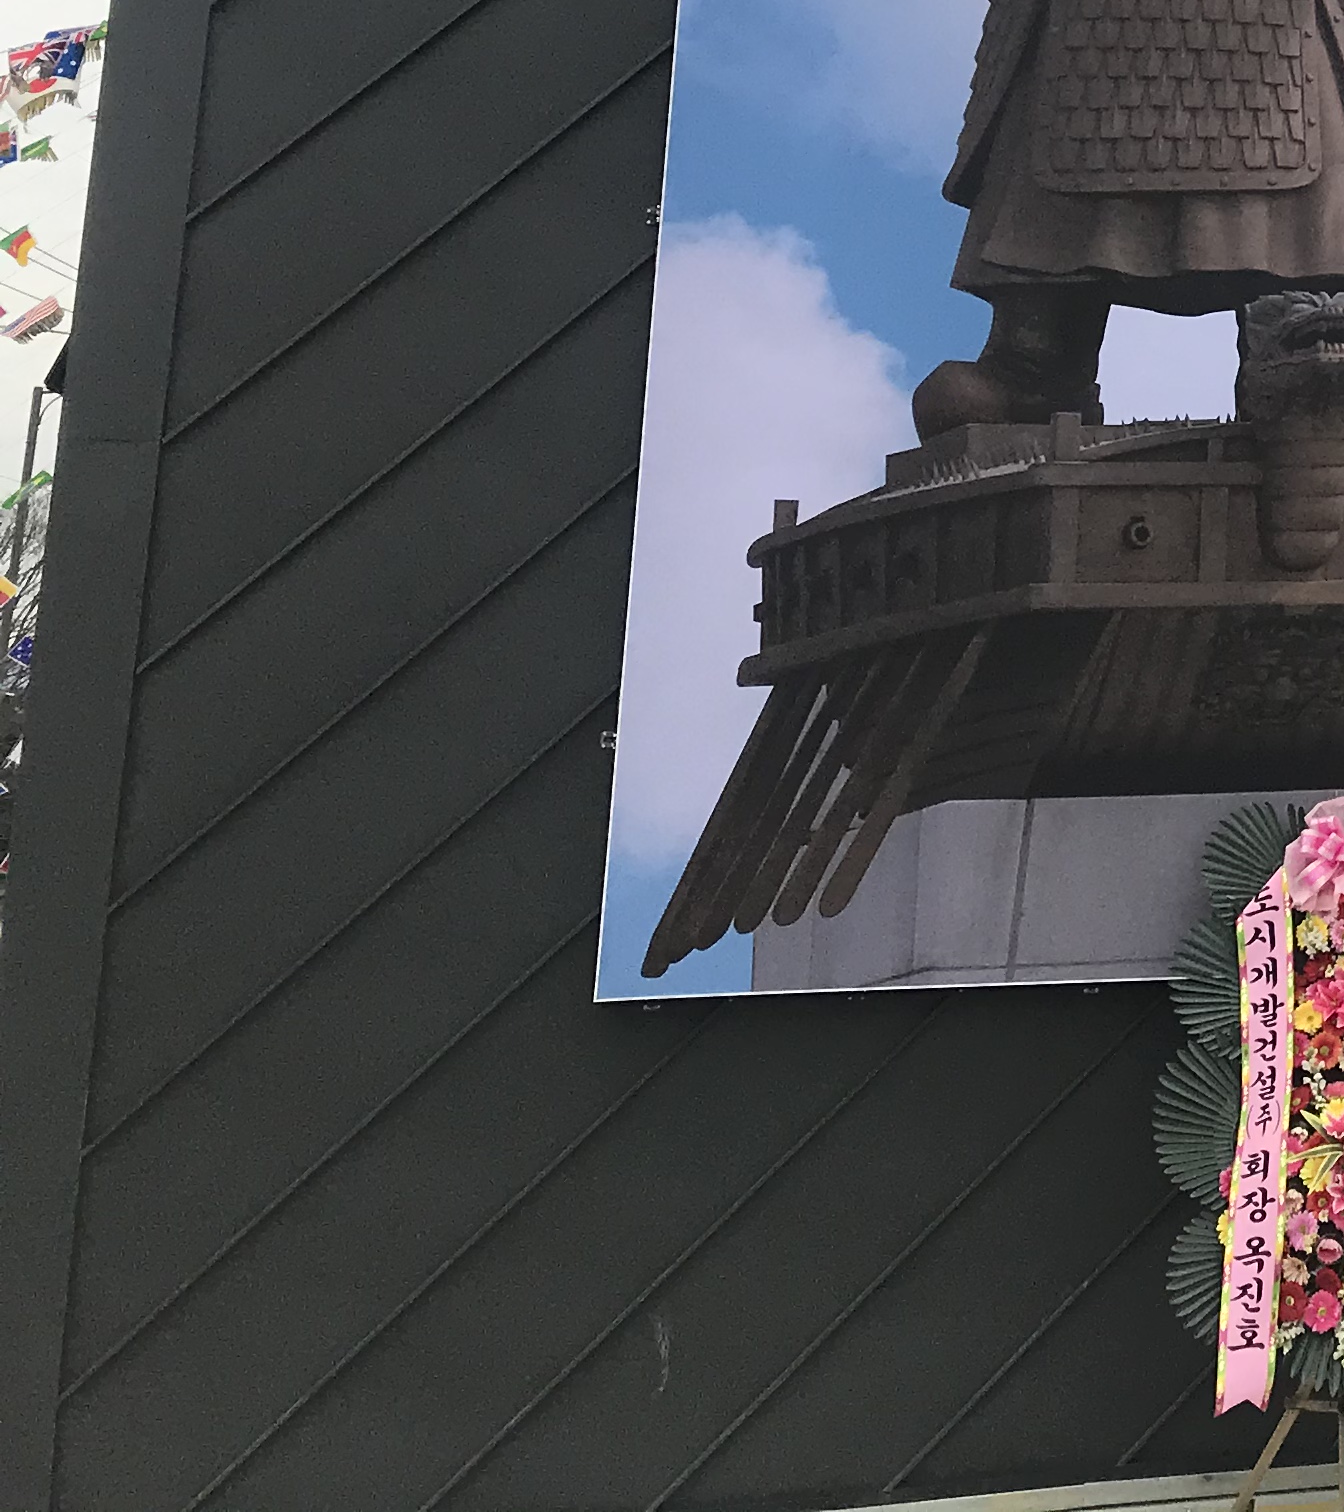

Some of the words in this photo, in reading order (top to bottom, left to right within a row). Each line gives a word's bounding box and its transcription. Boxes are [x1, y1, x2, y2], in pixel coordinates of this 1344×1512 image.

[1243, 886, 1285, 1139] 도시개발건설(주)
[1236, 1149, 1276, 1223] 회장
[1226, 1236, 1272, 1352] 옥진호
